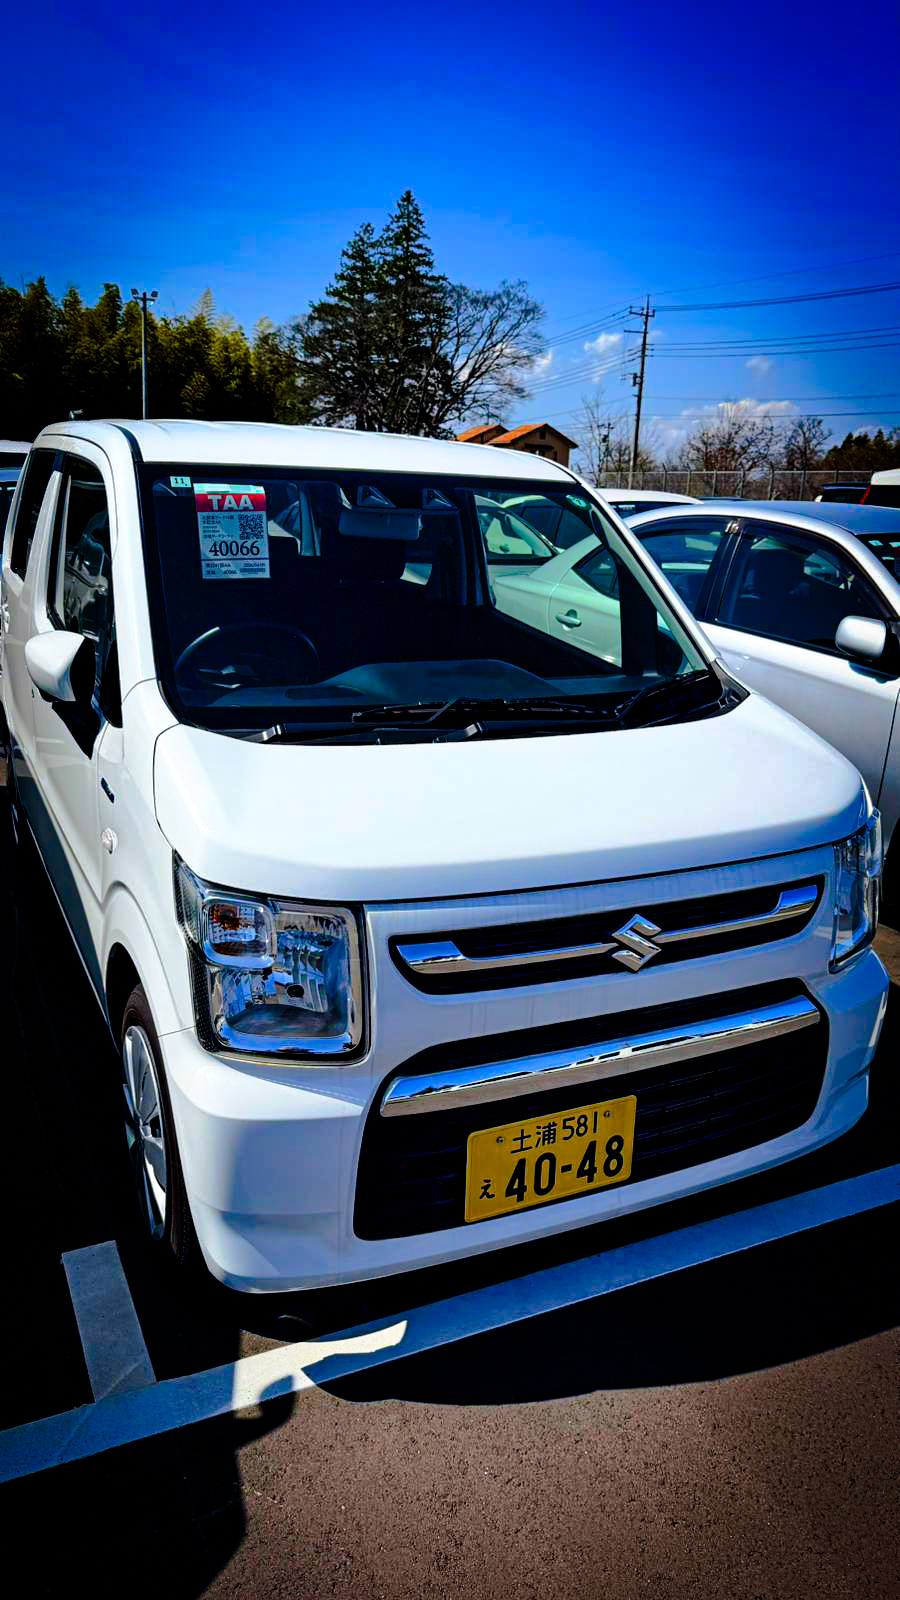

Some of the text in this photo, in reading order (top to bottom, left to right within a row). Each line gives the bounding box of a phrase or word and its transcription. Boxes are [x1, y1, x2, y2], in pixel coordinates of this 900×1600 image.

[207, 495, 254, 510] TAA
[209, 540, 260, 556] 40066
[562, 1111, 598, 1140] 581
[479, 1135, 625, 1203] え 40-48
